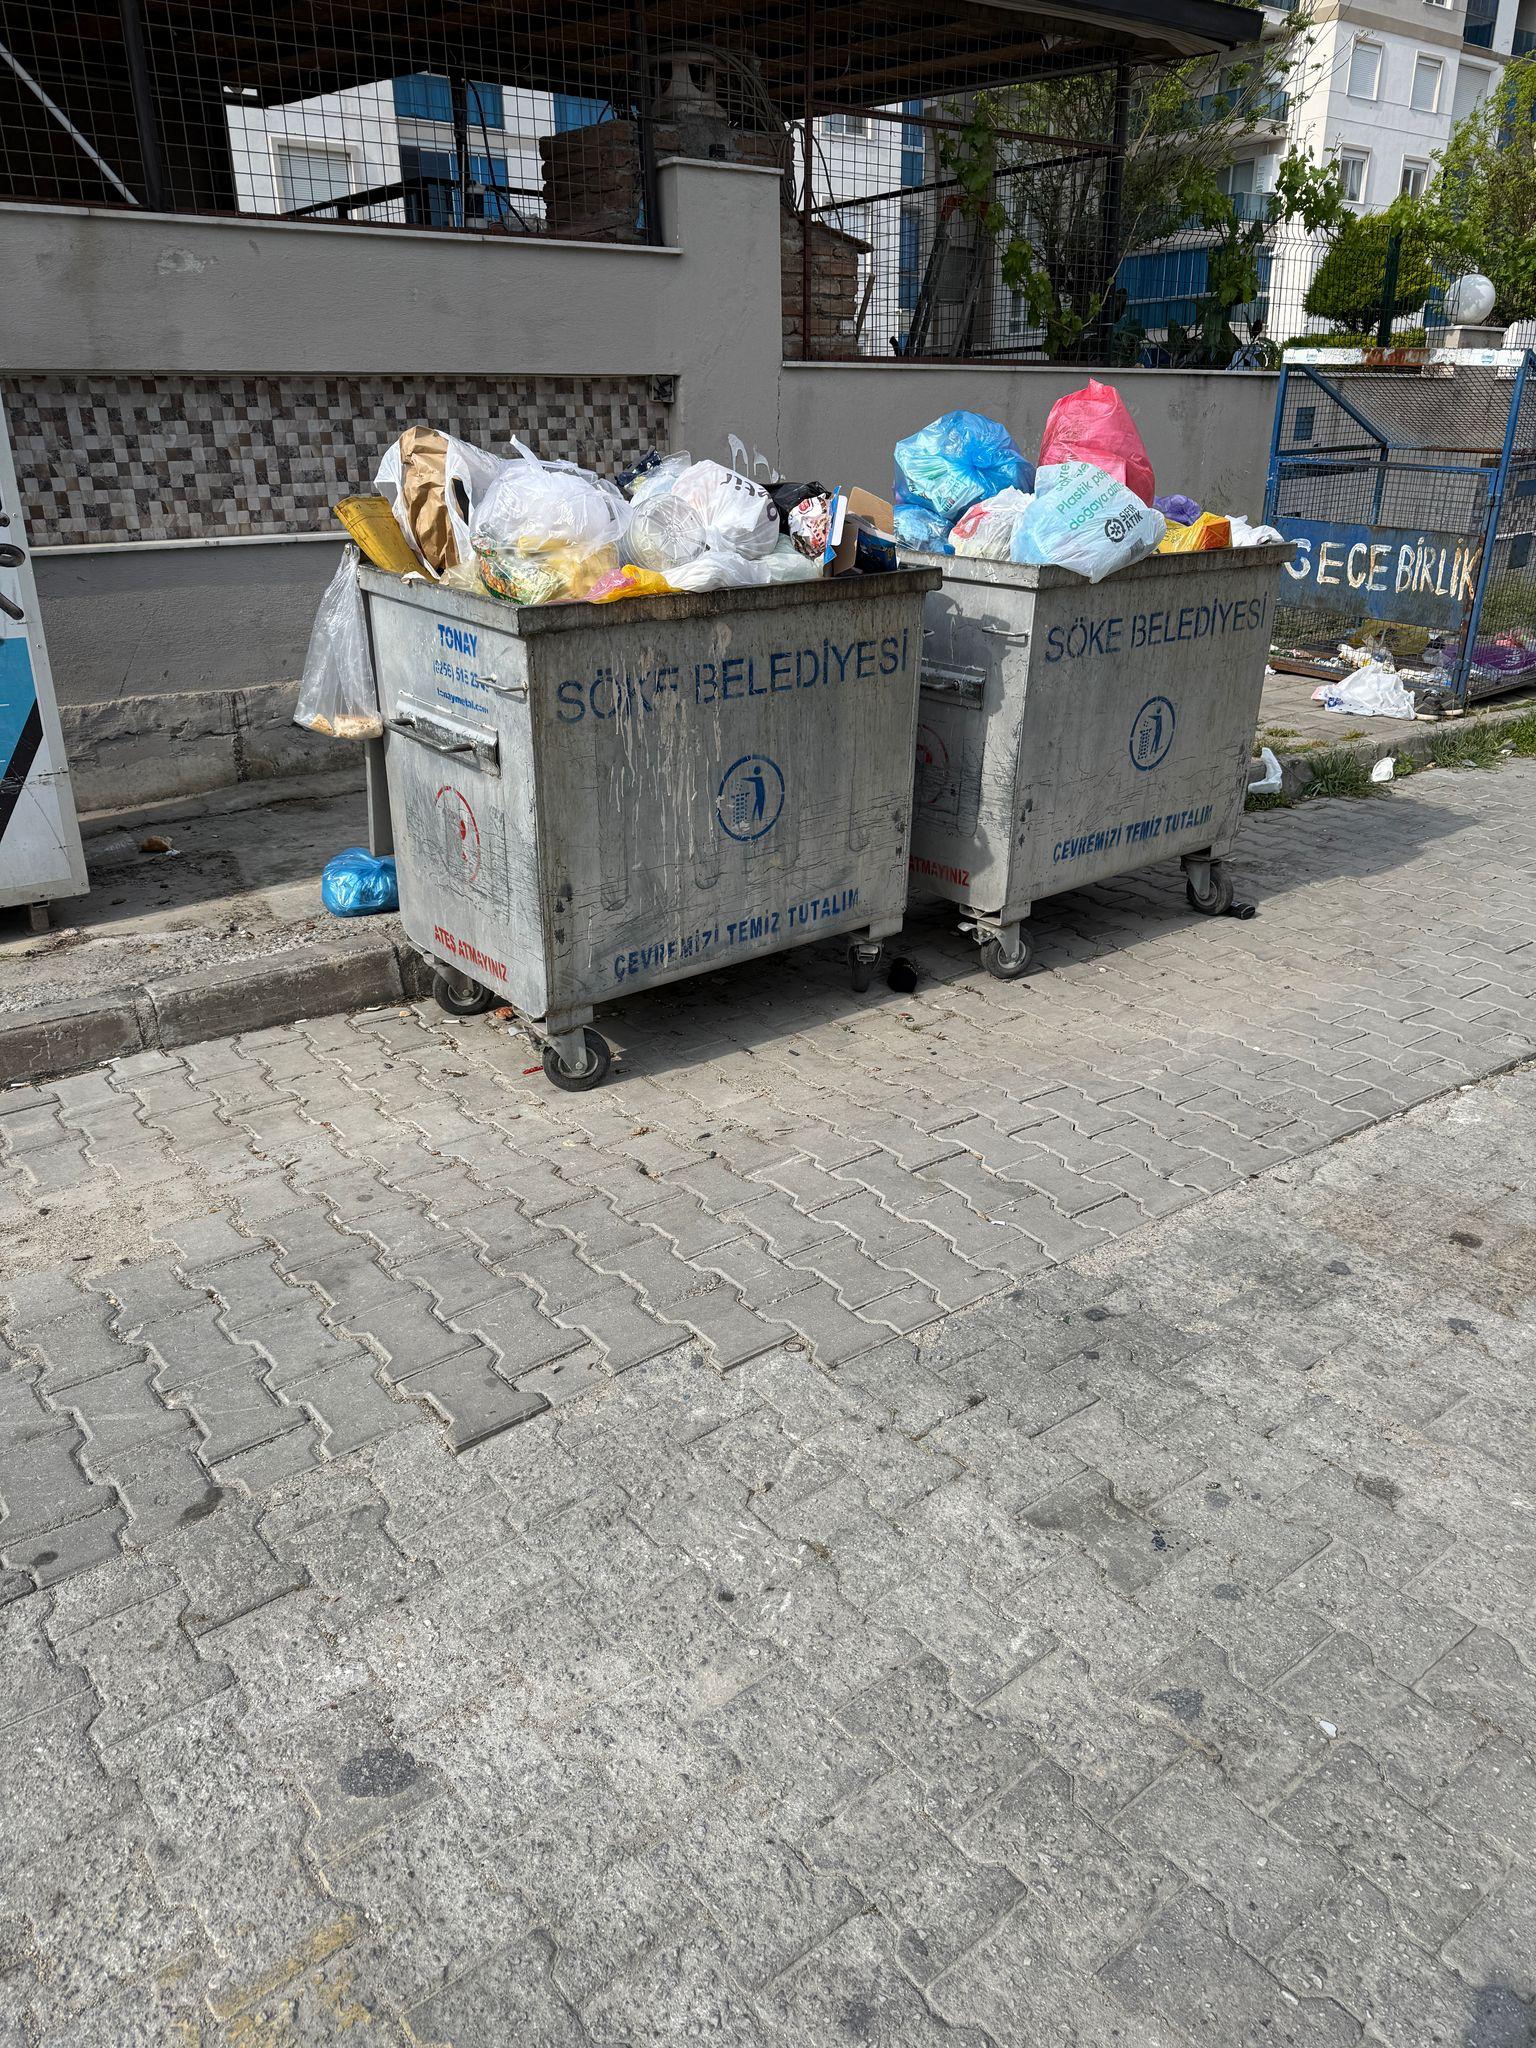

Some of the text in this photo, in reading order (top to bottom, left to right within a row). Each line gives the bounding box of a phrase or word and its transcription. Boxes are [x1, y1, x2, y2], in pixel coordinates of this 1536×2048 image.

[1056, 481, 1093, 515] Plastik
[1070, 493, 1108, 530] doğaya
[1125, 510, 1143, 531] ATIK
[438, 624, 477, 657] TONAY
[1045, 591, 1268, 663] SÖKE BELEDİYESİ
[695, 628, 908, 704] BELEDİYESİ
[437, 687, 488, 713] tonaymetal.com
[727, 909, 780, 945] TEMİZ
[788, 887, 859, 928] TUTALIM
[434, 924, 508, 982] ATEŞ ATMAYINIZ
